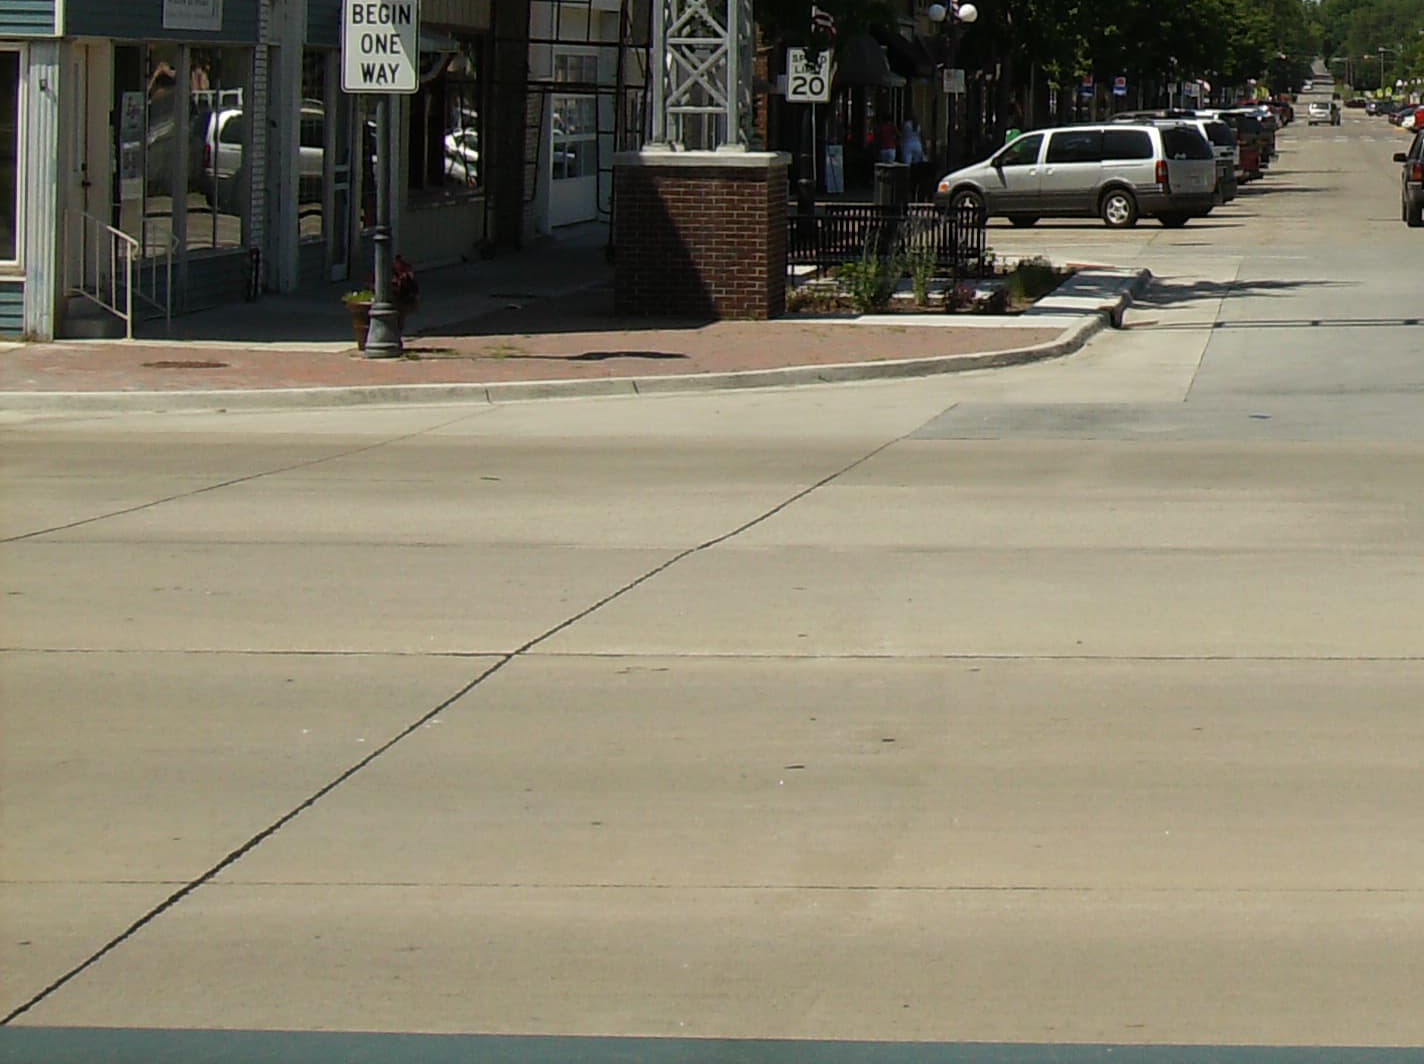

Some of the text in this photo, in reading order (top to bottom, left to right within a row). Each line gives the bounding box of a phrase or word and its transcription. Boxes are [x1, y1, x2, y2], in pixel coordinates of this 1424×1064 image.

[352, 3, 412, 25] BEGIN
[361, 33, 401, 55] ONE
[361, 62, 400, 84] WAY
[791, 76, 825, 96] 20
